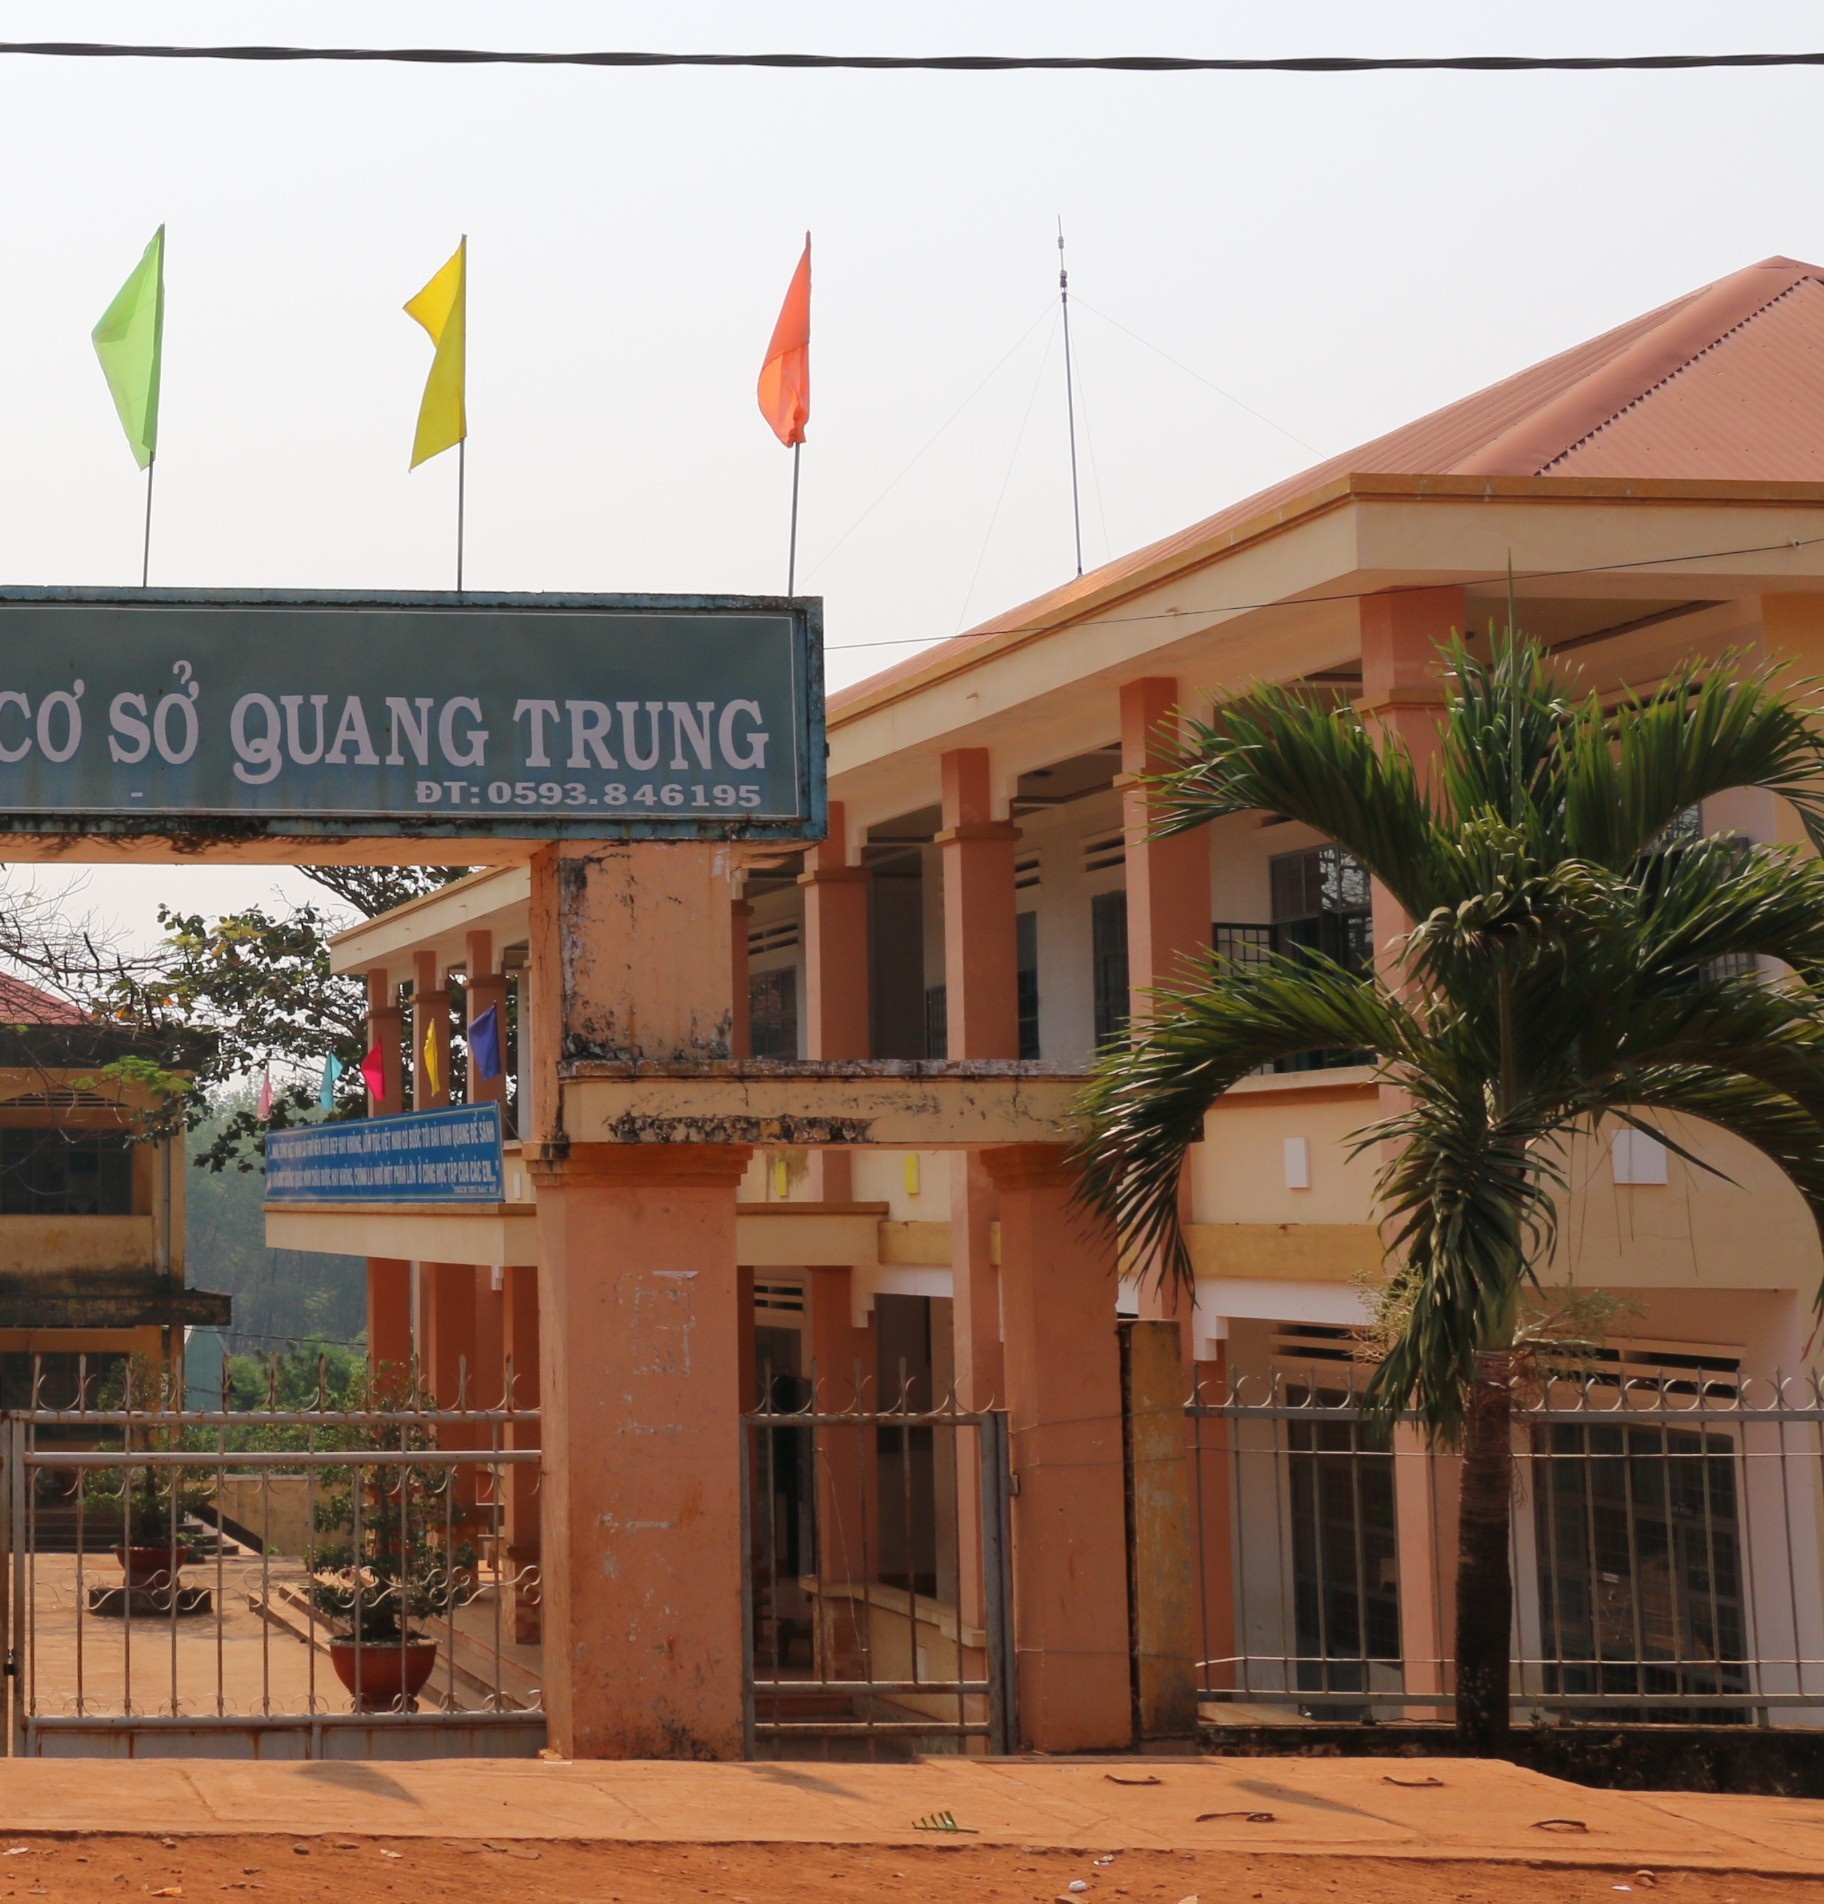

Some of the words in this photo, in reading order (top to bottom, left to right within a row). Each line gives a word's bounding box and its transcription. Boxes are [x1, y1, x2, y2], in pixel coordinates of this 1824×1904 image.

[108, 660, 200, 765] SỞ
[230, 692, 489, 785] QUANG
[513, 699, 769, 771] TRUNG
[415, 780, 761, 807] ĐT:0593.846195
